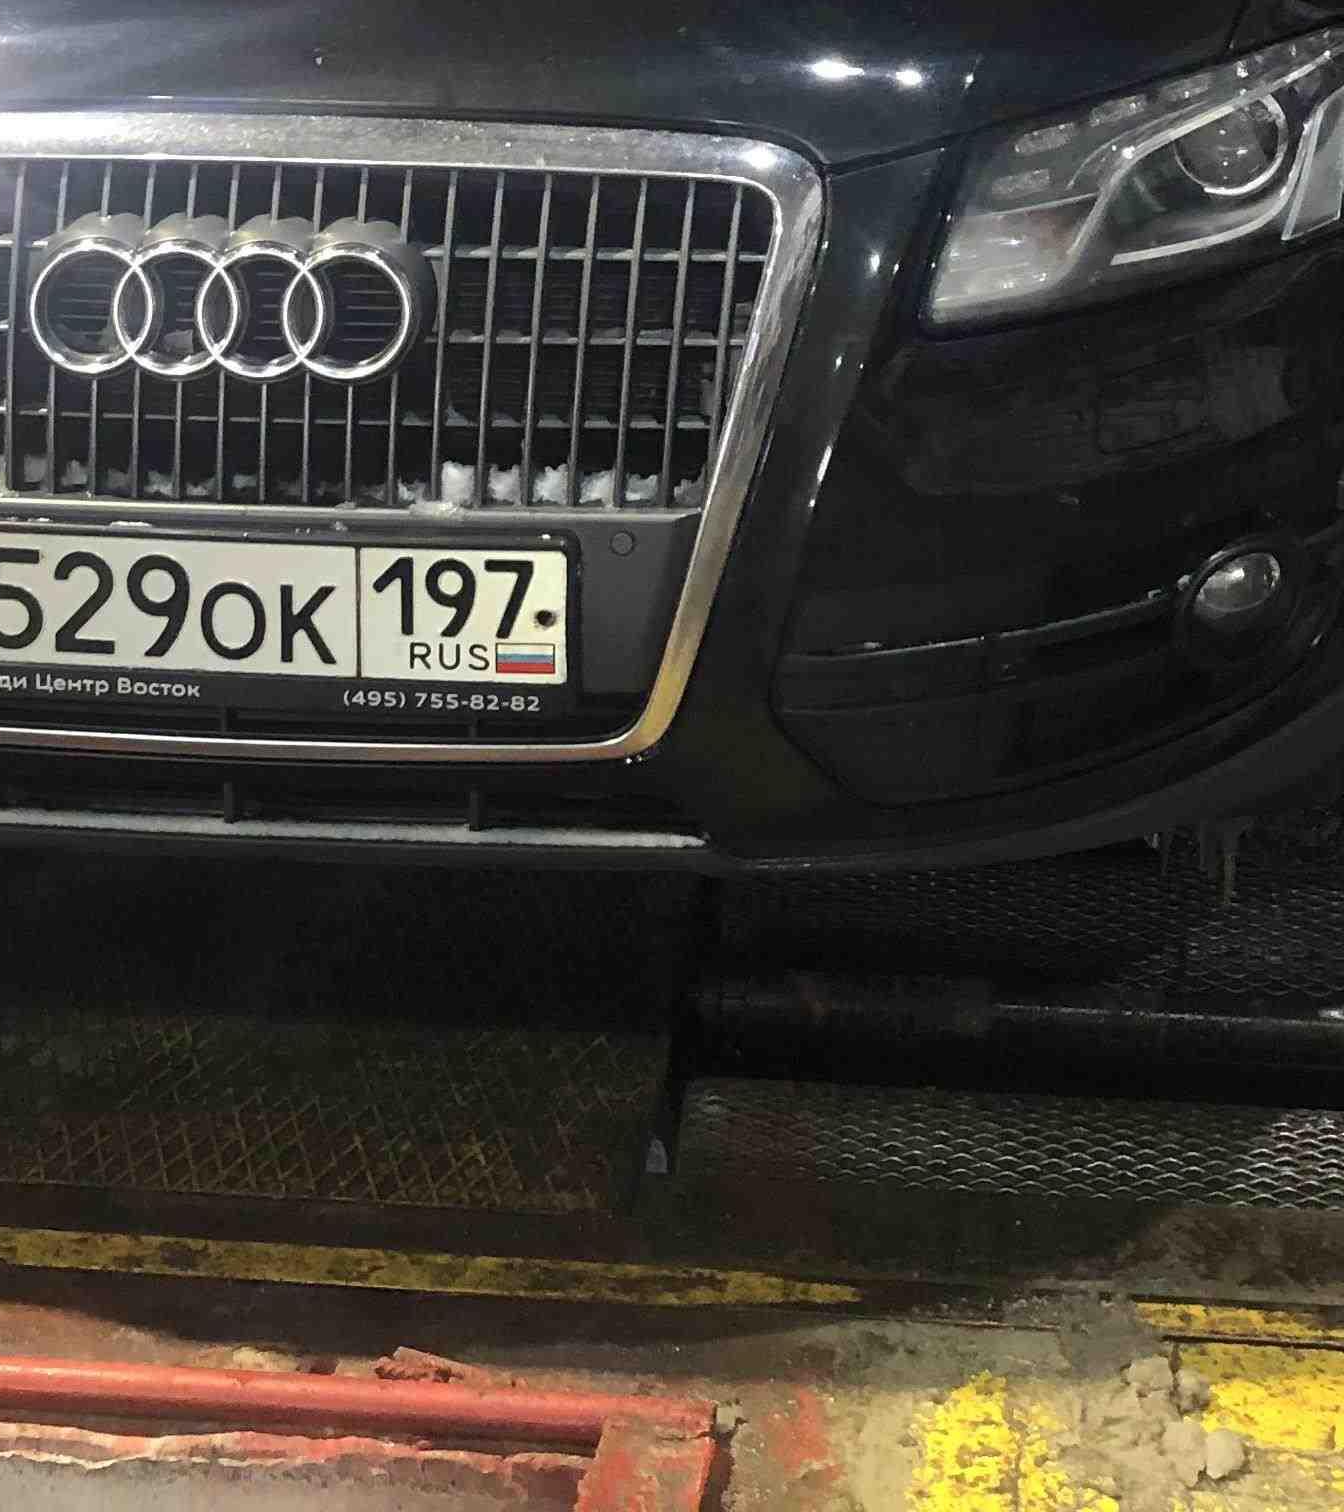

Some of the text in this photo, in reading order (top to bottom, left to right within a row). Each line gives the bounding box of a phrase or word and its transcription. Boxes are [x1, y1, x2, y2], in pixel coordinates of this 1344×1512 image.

[372, 556, 535, 640] 197
[409, 641, 490, 671] RUS
[35, 672, 110, 697] Центр
[117, 676, 200, 698] Восток
[342, 689, 541, 712] (495) 755-82-82
